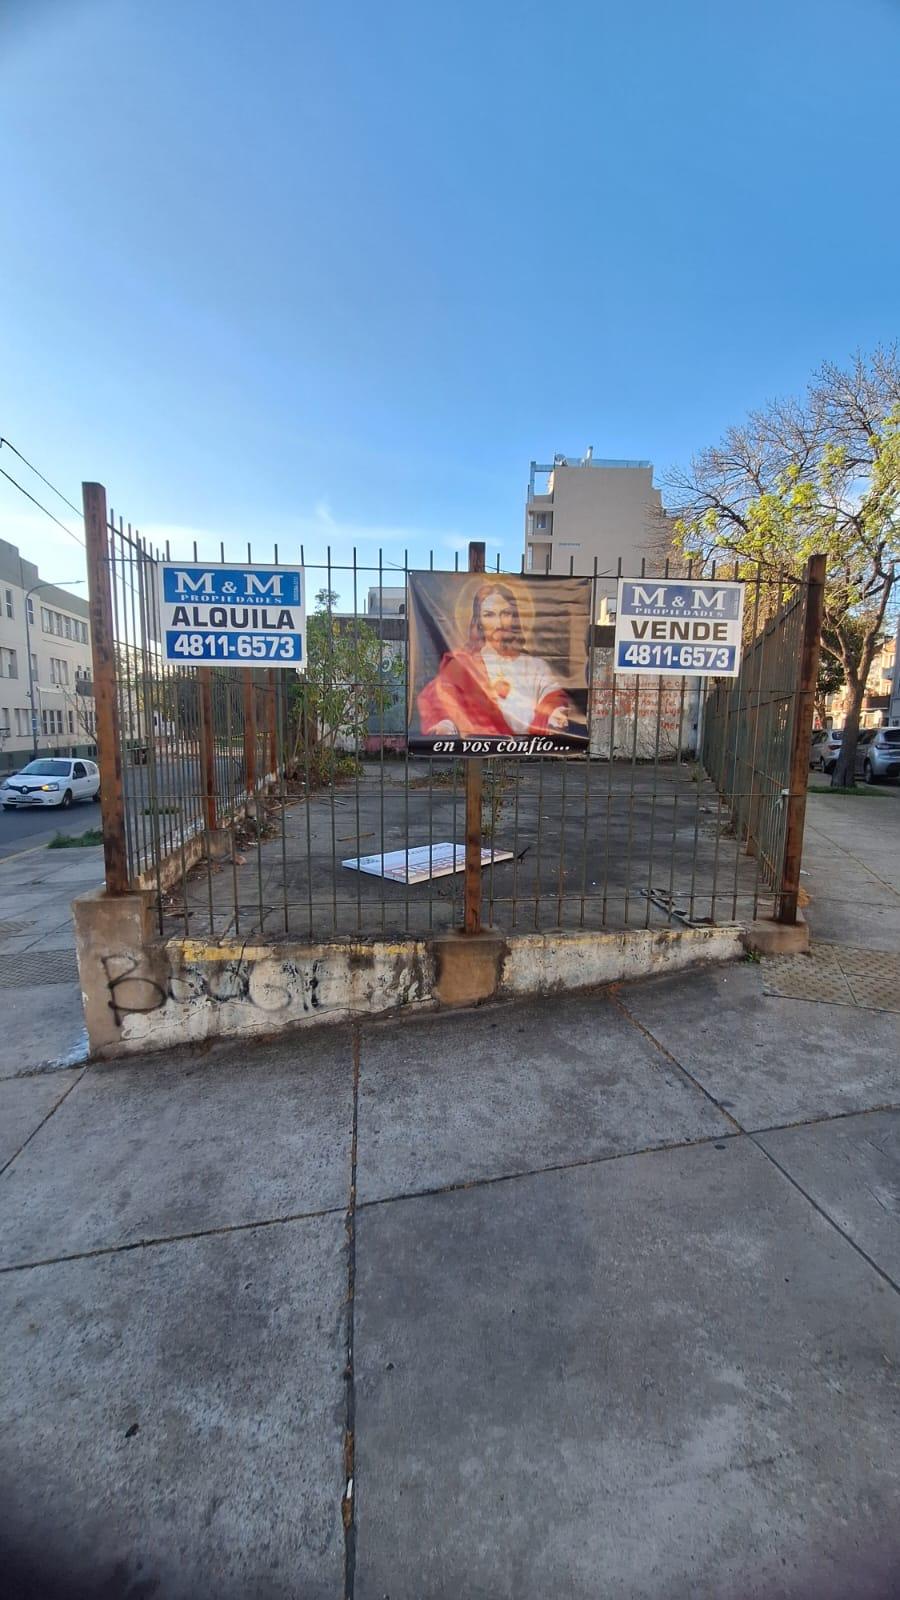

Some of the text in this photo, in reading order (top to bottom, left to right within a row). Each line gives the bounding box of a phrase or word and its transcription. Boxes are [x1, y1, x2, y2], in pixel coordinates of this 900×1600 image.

[174, 571, 215, 594] M
[221, 581, 237, 594] &
[244, 574, 284, 596] M
[180, 594, 282, 604] PROPIEDADES
[631, 586, 668, 607] M
[671, 595, 686, 608] &
[691, 589, 727, 610] M
[171, 606, 295, 629] ALQUILA
[635, 607, 723, 618] PROPIEDADES
[631, 620, 728, 641] VENDE
[174, 634, 294, 658] 4811-6573
[625, 644, 729, 668] 4811-6573
[433, 737, 570, 755] en vos confío...
